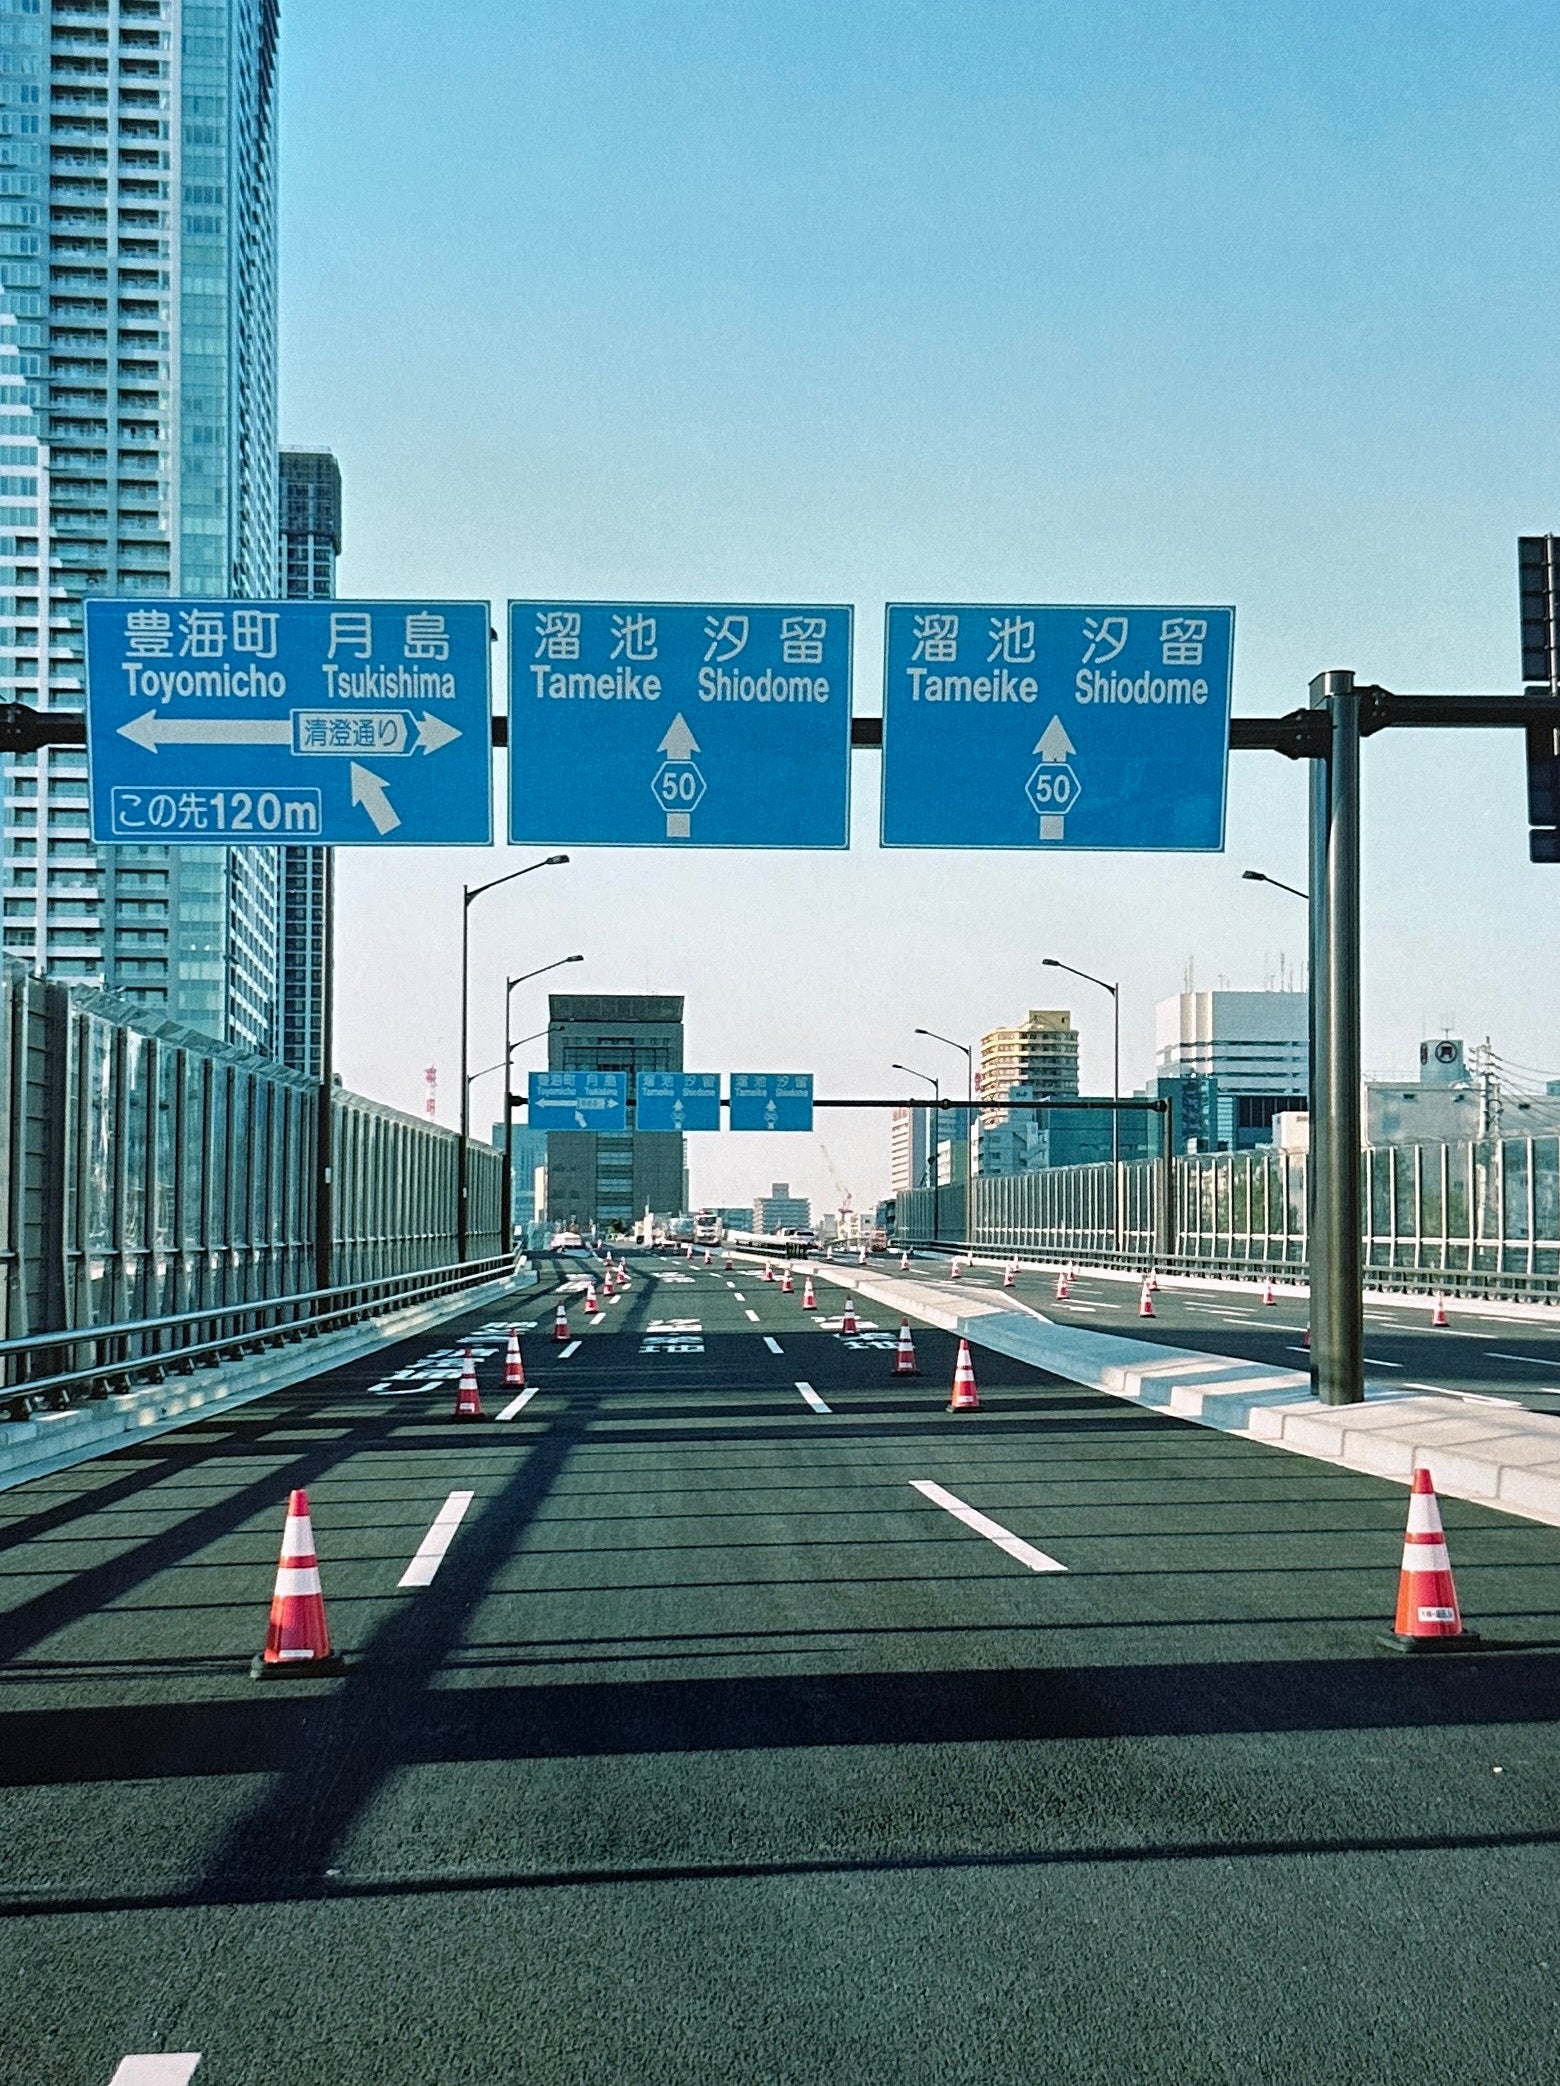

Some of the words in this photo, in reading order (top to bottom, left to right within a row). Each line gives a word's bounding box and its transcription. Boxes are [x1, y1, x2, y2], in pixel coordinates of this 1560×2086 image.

[125, 608, 280, 659] 豊海町
[327, 610, 450, 661] 月島
[534, 611, 658, 661] 溜池
[704, 615, 827, 664] 汐留
[911, 614, 1036, 663] 溜池
[1082, 617, 1208, 665] 汐留
[121, 662, 286, 703] Toyomicho
[322, 664, 456, 700] Tsukishima
[530, 664, 662, 700] Tameike
[698, 666, 830, 703] Shiodome
[906, 667, 1038, 702] Tameike
[1075, 668, 1208, 705] Shiodome
[304, 719, 398, 748] 清澄通り
[662, 772, 696, 801] 50
[1036, 774, 1070, 803] 50
